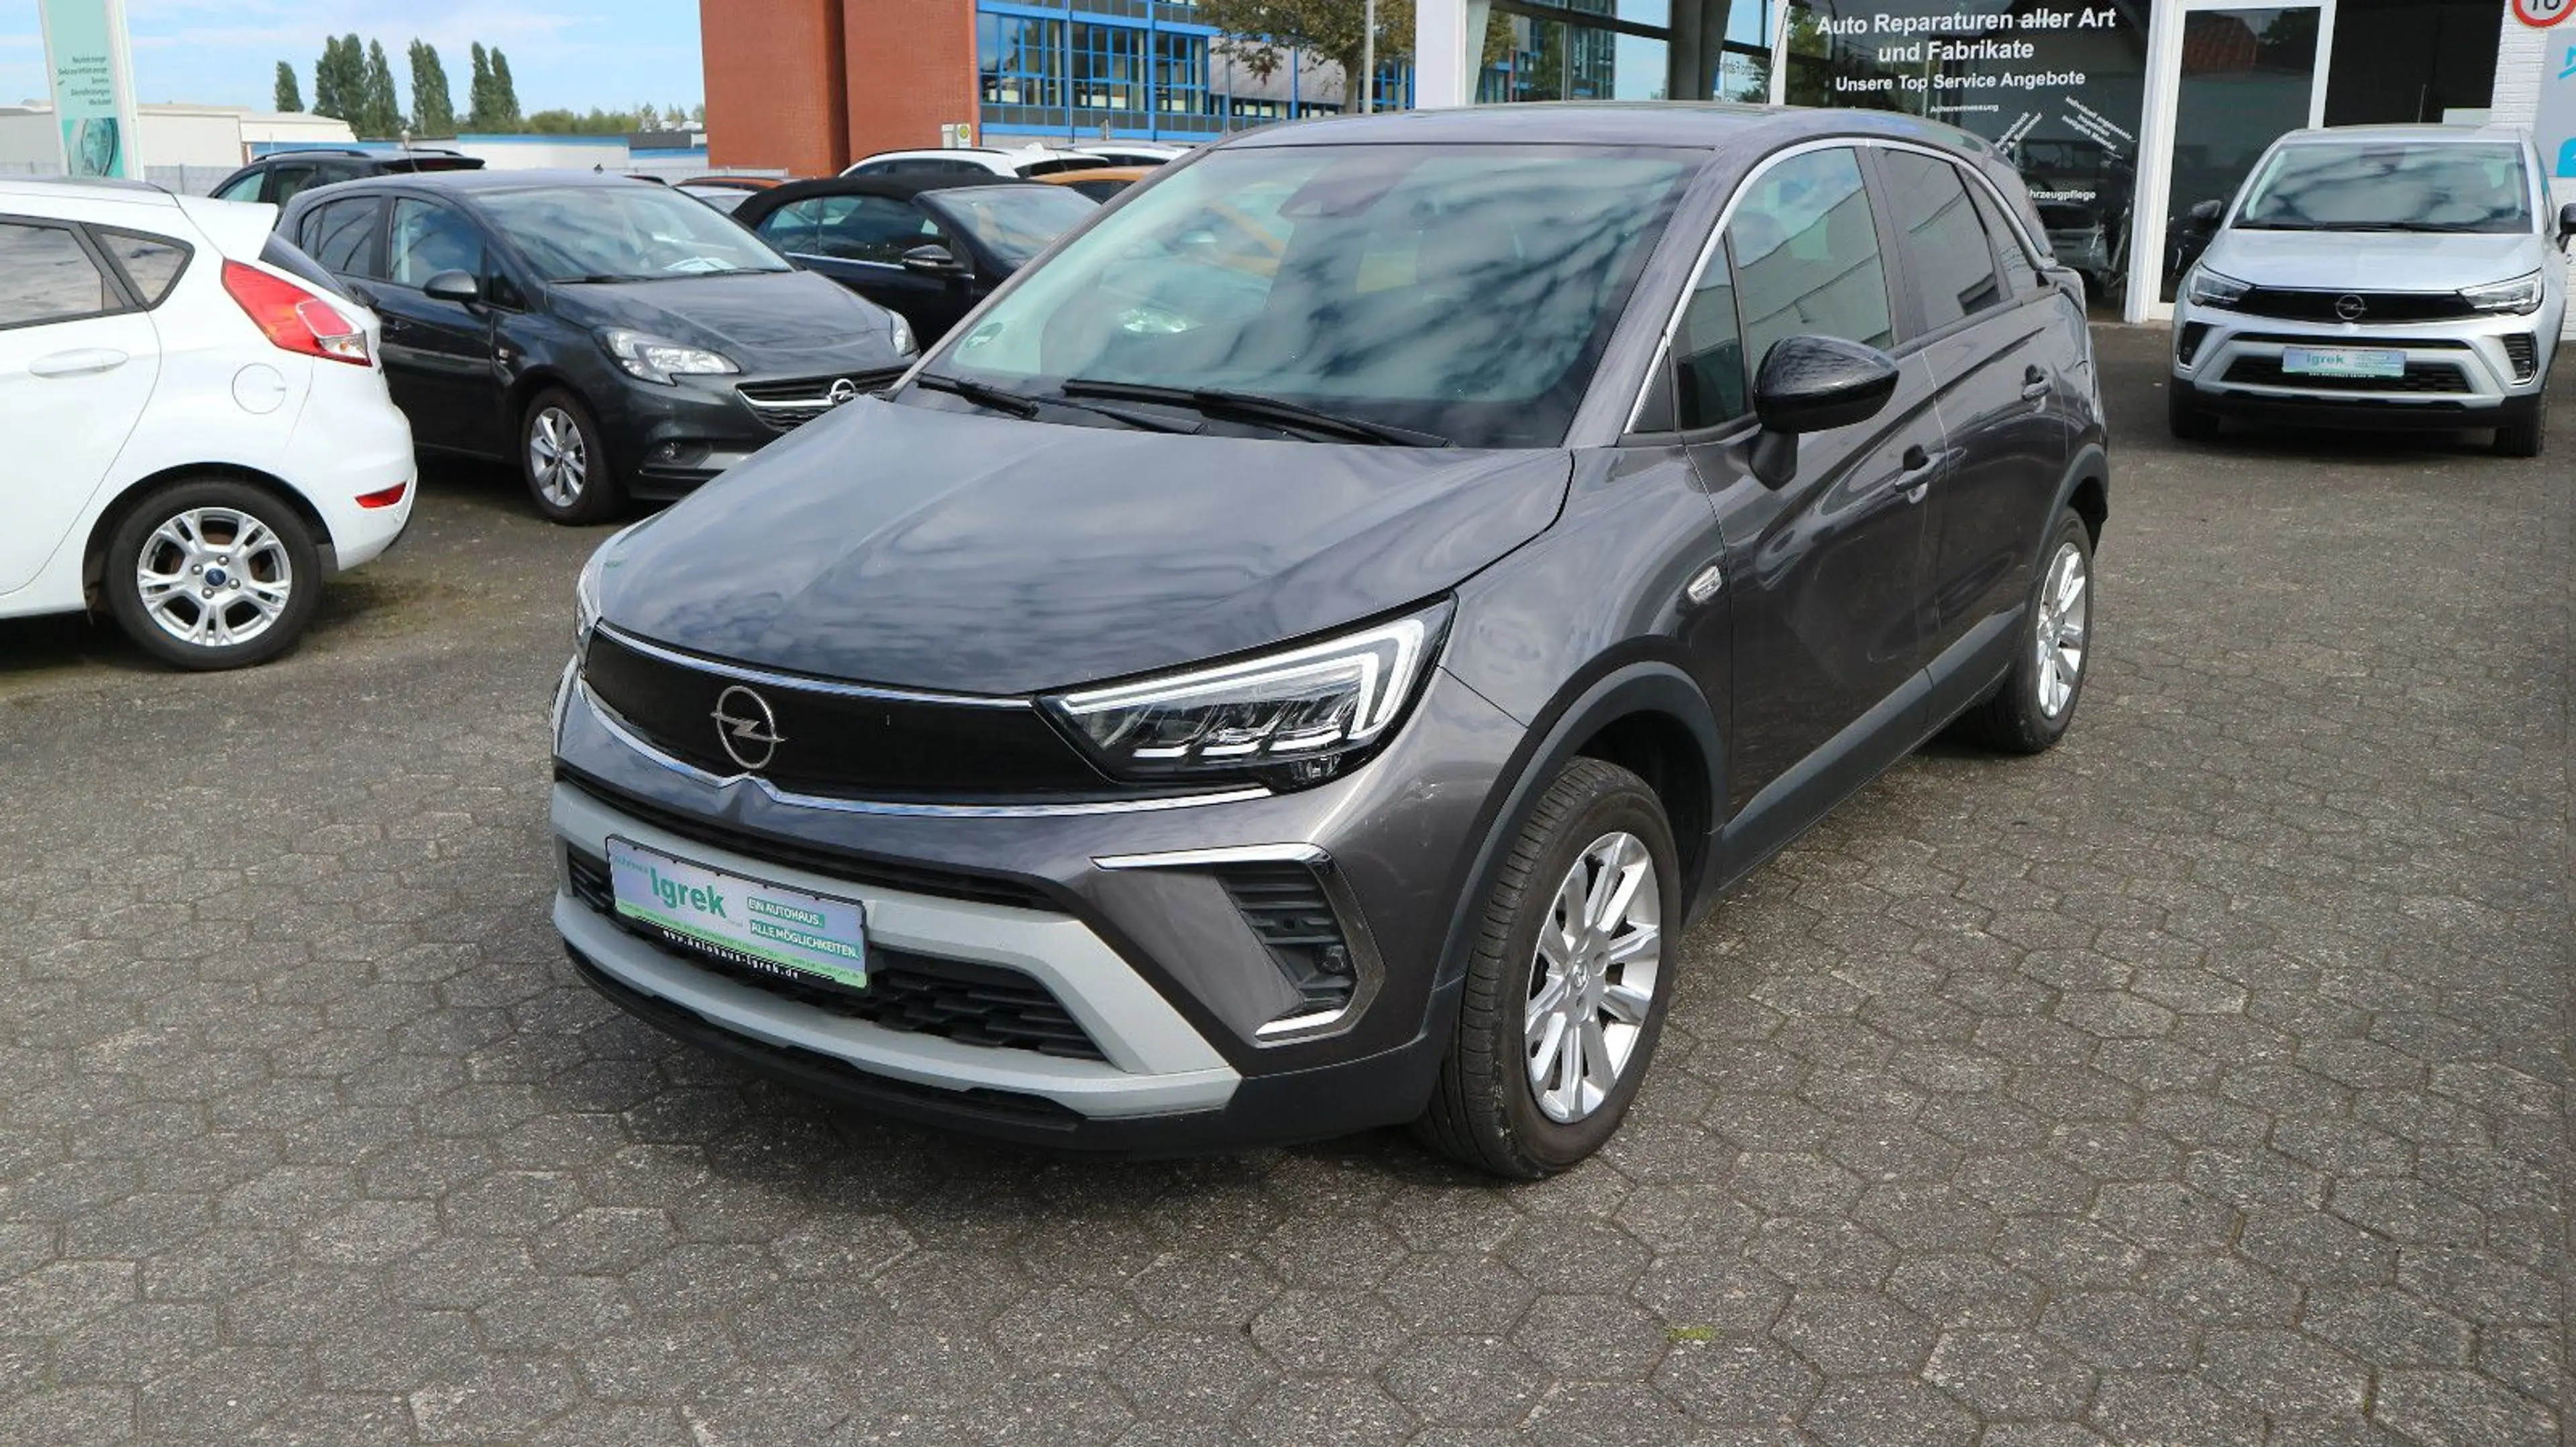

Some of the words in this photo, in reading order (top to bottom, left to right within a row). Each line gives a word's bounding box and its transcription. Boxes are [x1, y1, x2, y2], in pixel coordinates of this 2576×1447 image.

[1816, 16, 1868, 35] Auto
[1874, 11, 2013, 36] Reparaturen
[2021, 8, 2074, 28] aller
[2078, 7, 2116, 28] Art
[1879, 42, 1920, 62] und
[1927, 39, 2034, 60] Fabrikate
[1835, 76, 1892, 91] Unsere
[1898, 74, 1928, 93] Top
[1933, 72, 1996, 89] Service
[2000, 70, 2086, 90] Angebote
[2029, 189, 2096, 202] hrzeugpflege
[649, 867, 727, 919] Igrek
[748, 898, 765, 912] EIN
[751, 921, 777, 939] ALLE
